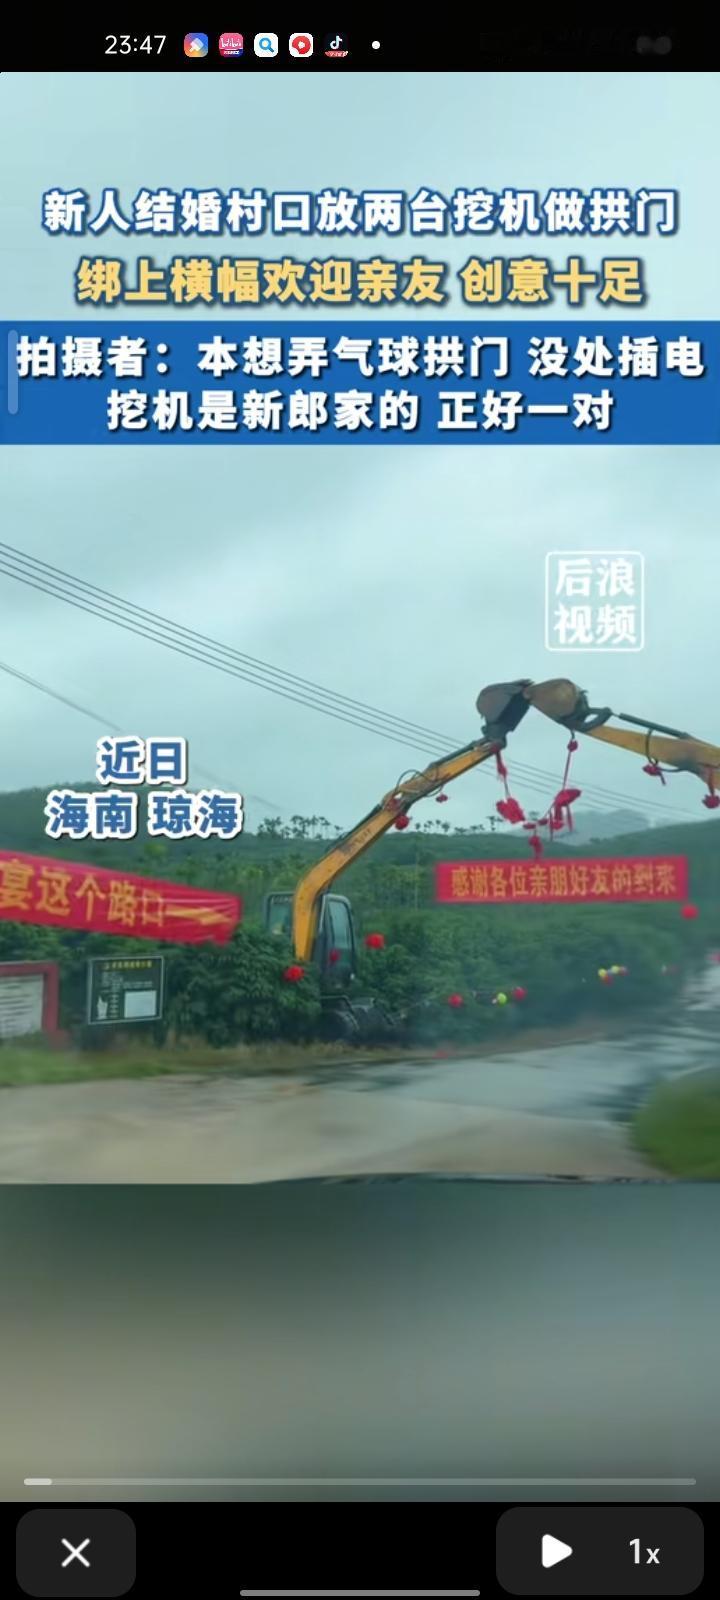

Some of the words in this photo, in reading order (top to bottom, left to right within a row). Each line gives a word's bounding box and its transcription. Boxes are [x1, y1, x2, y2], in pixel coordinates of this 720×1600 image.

[105, 35, 166, 54] 23:47
[451, 863, 677, 898] 感谢各位亲朋好友的到来
[629, 1538, 660, 1564] 1x
